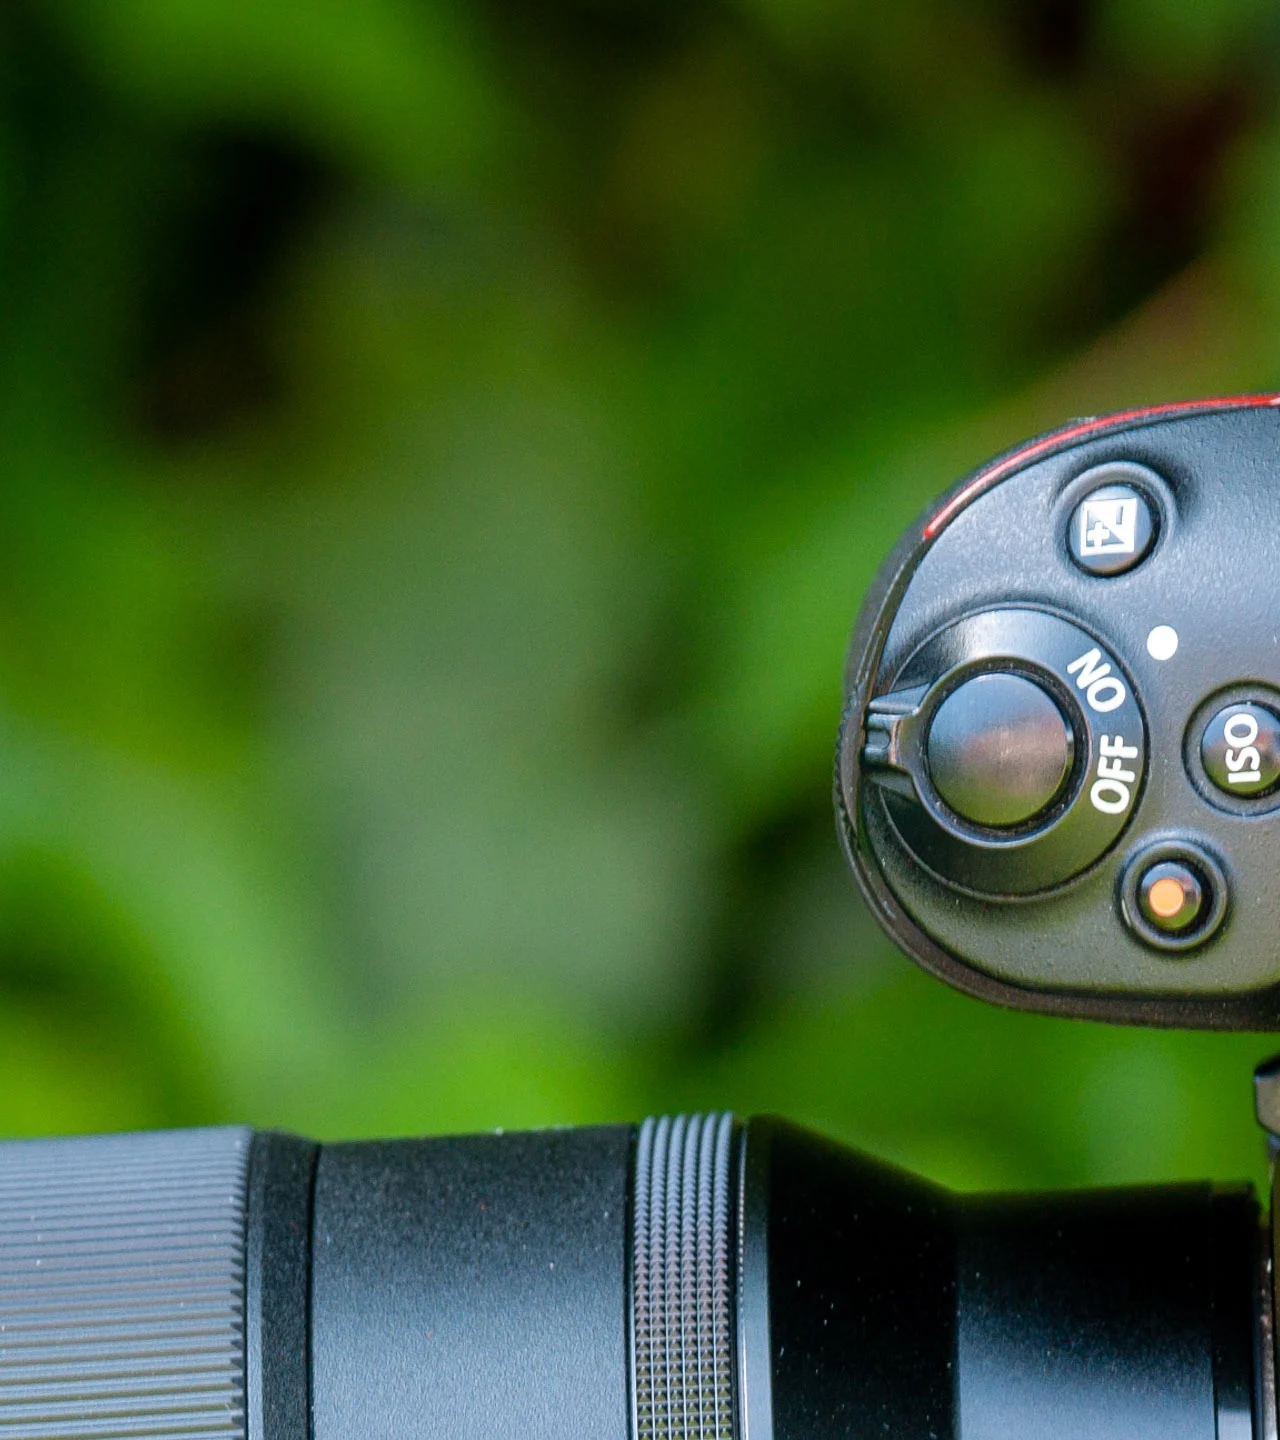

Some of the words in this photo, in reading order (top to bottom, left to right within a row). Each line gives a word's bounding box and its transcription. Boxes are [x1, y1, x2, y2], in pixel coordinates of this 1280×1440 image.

[1067, 648, 1126, 713] ON
[1090, 734, 1139, 813] OFF
[1223, 714, 1261, 784] ISO
